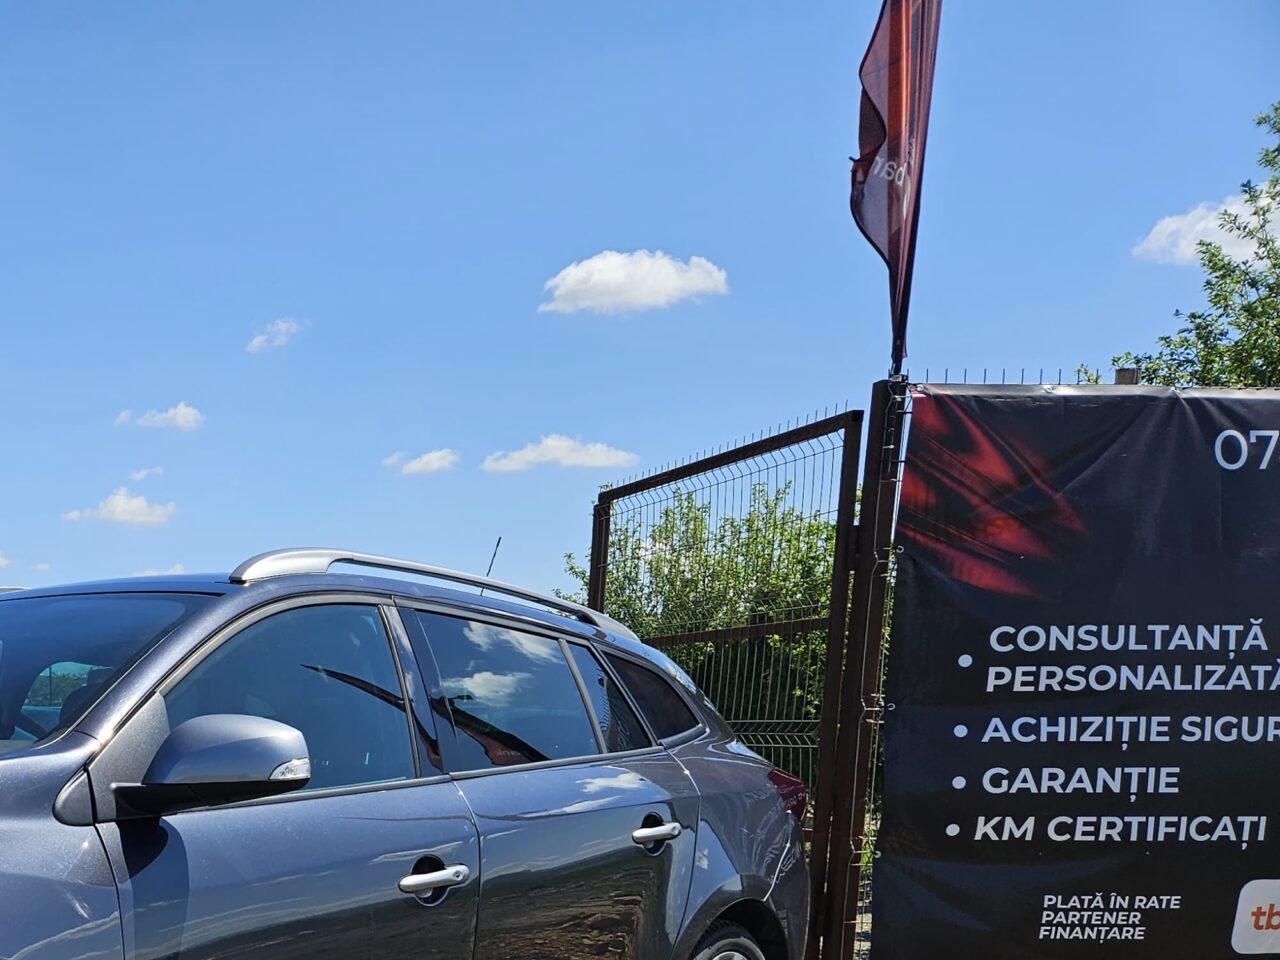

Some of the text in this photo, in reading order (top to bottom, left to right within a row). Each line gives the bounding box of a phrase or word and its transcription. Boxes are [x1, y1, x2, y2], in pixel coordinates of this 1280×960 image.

[1214, 429, 1279, 470] 07
[989, 618, 1269, 660] CONSULTANȚĂ
[981, 716, 1170, 751] ACHIZIȚIE
[982, 767, 1180, 802] GARANȚIE
[974, 816, 1267, 850] KM CERTIFICAȚI
[1043, 892, 1181, 909] PLATĂ ÎN RATE
[1038, 926, 1146, 944] FINANȚARE
[1041, 911, 1141, 925] PARTENER
